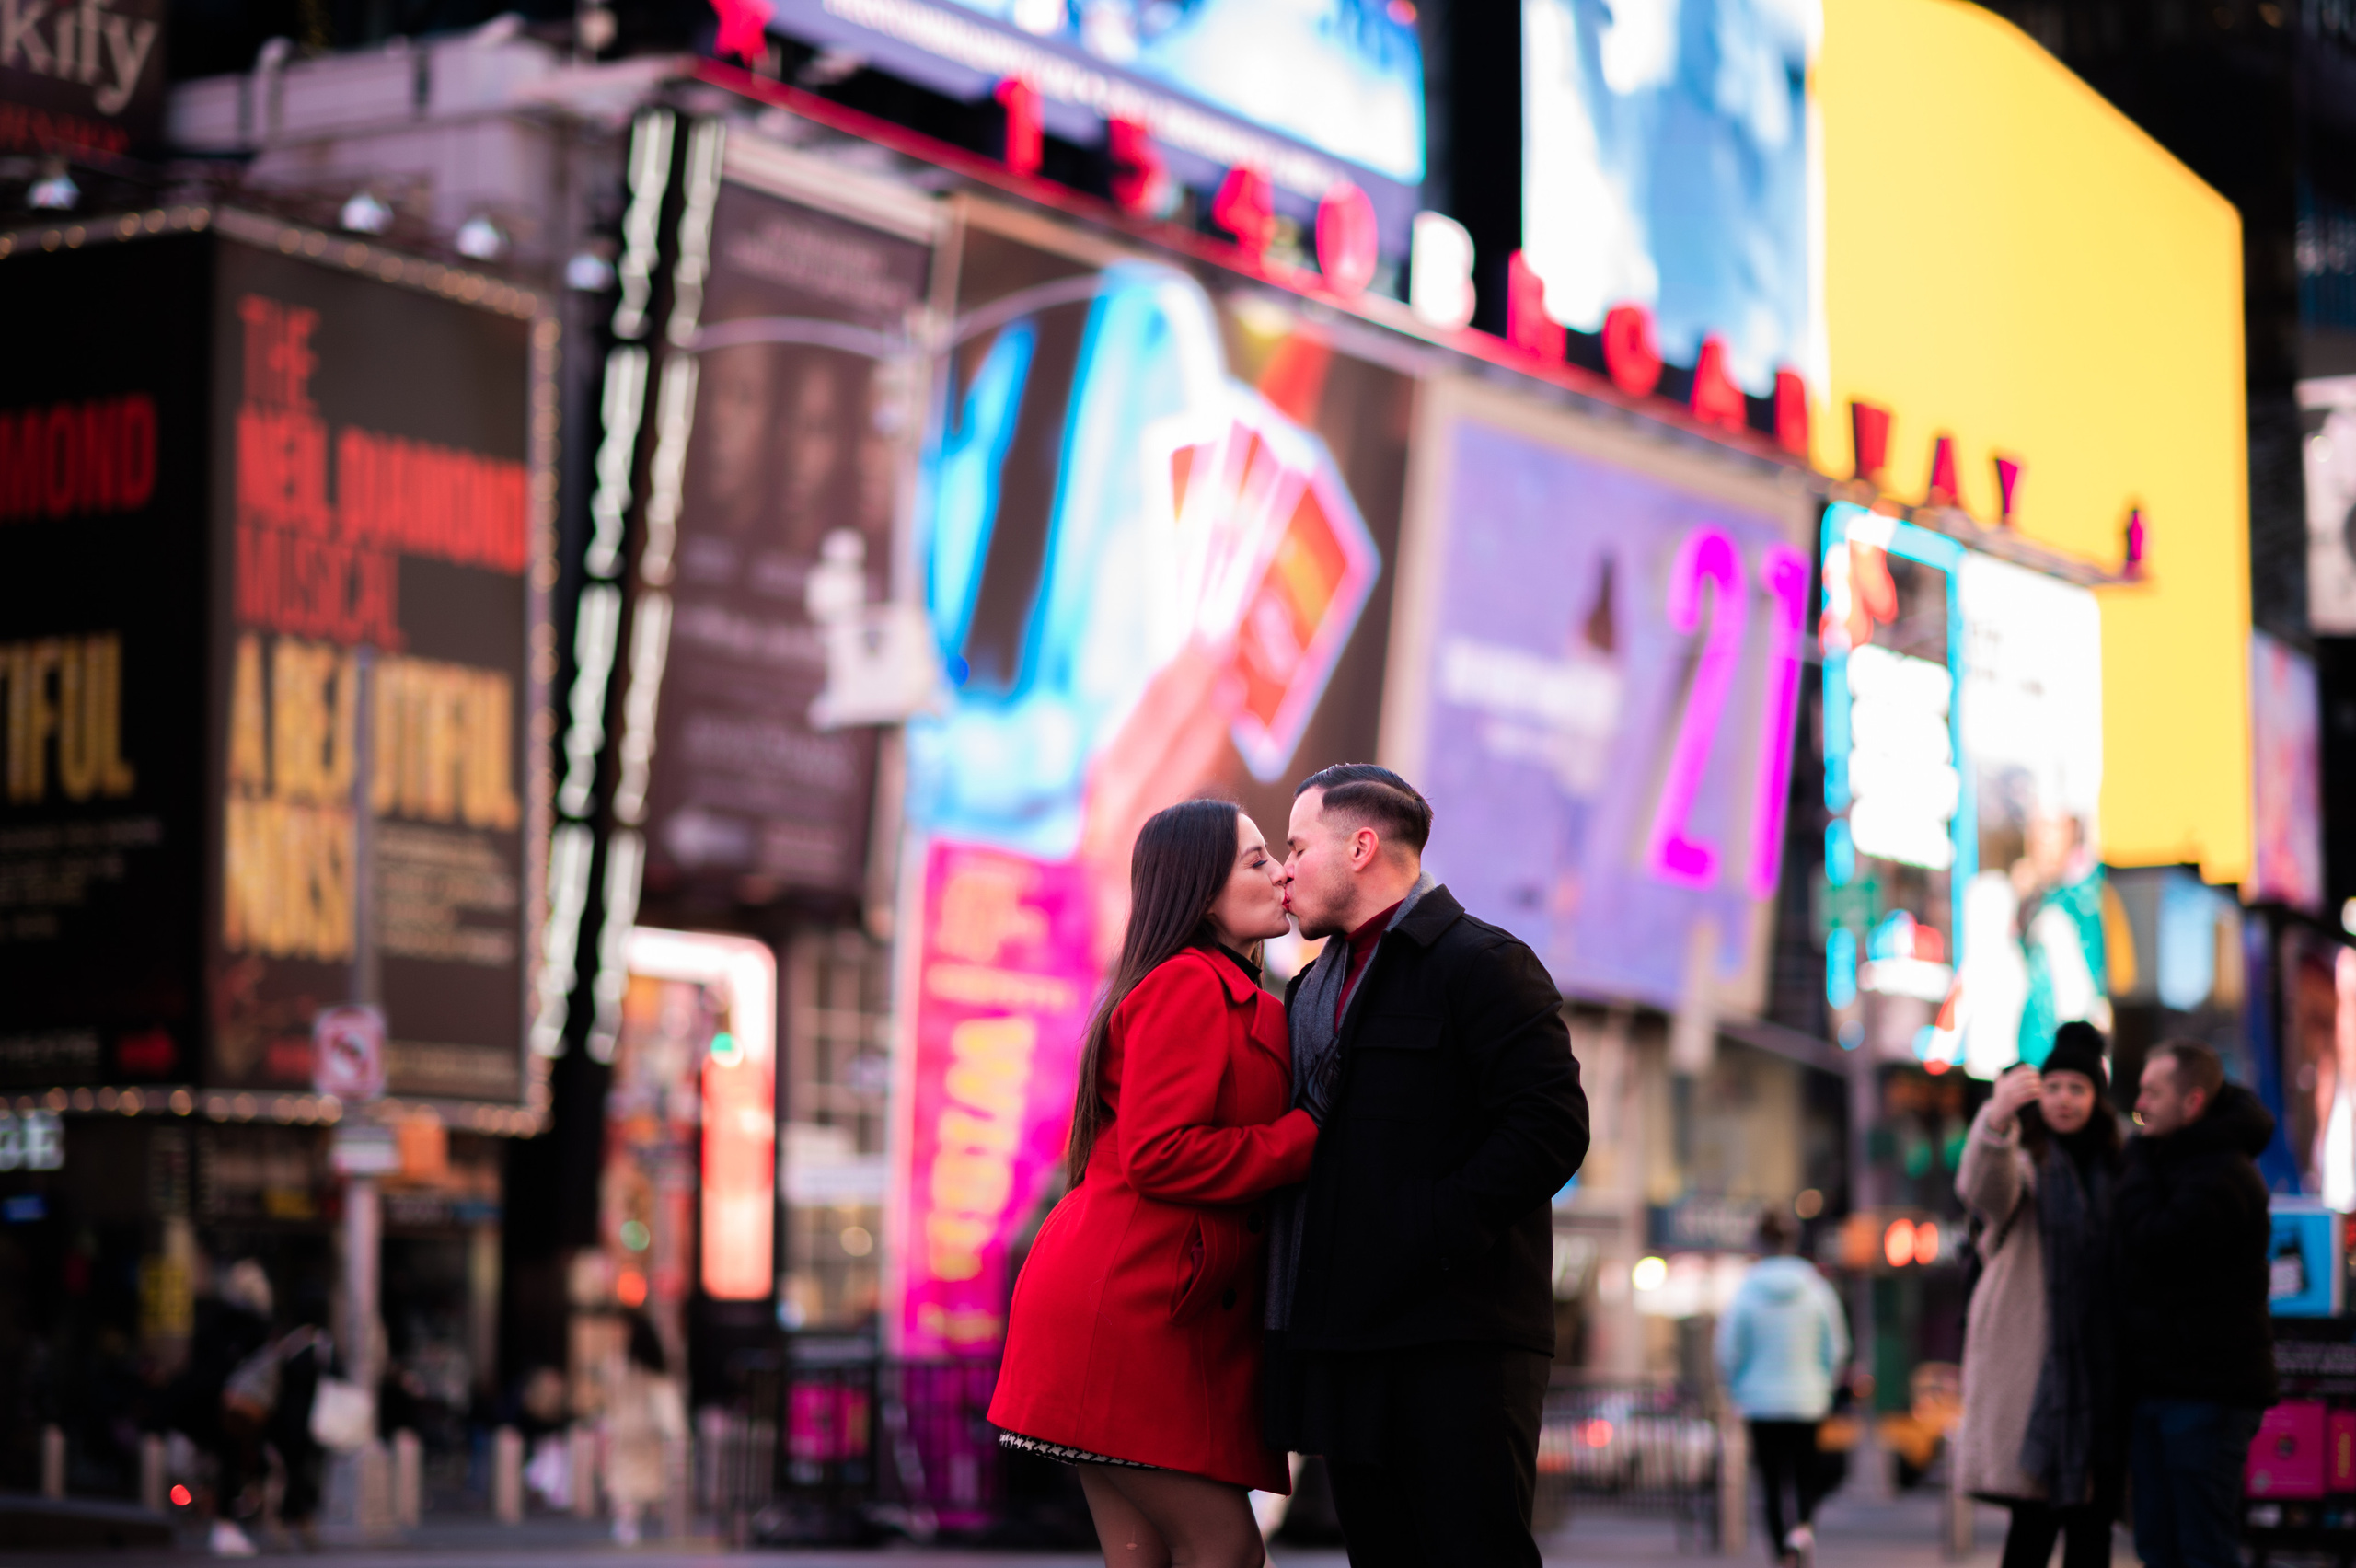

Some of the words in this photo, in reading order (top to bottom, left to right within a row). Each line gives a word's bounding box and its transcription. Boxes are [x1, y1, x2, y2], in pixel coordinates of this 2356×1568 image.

[239, 294, 319, 414] THE
[992, 73, 1379, 296] 1540
[1411, 209, 2019, 523] BROADWAY
